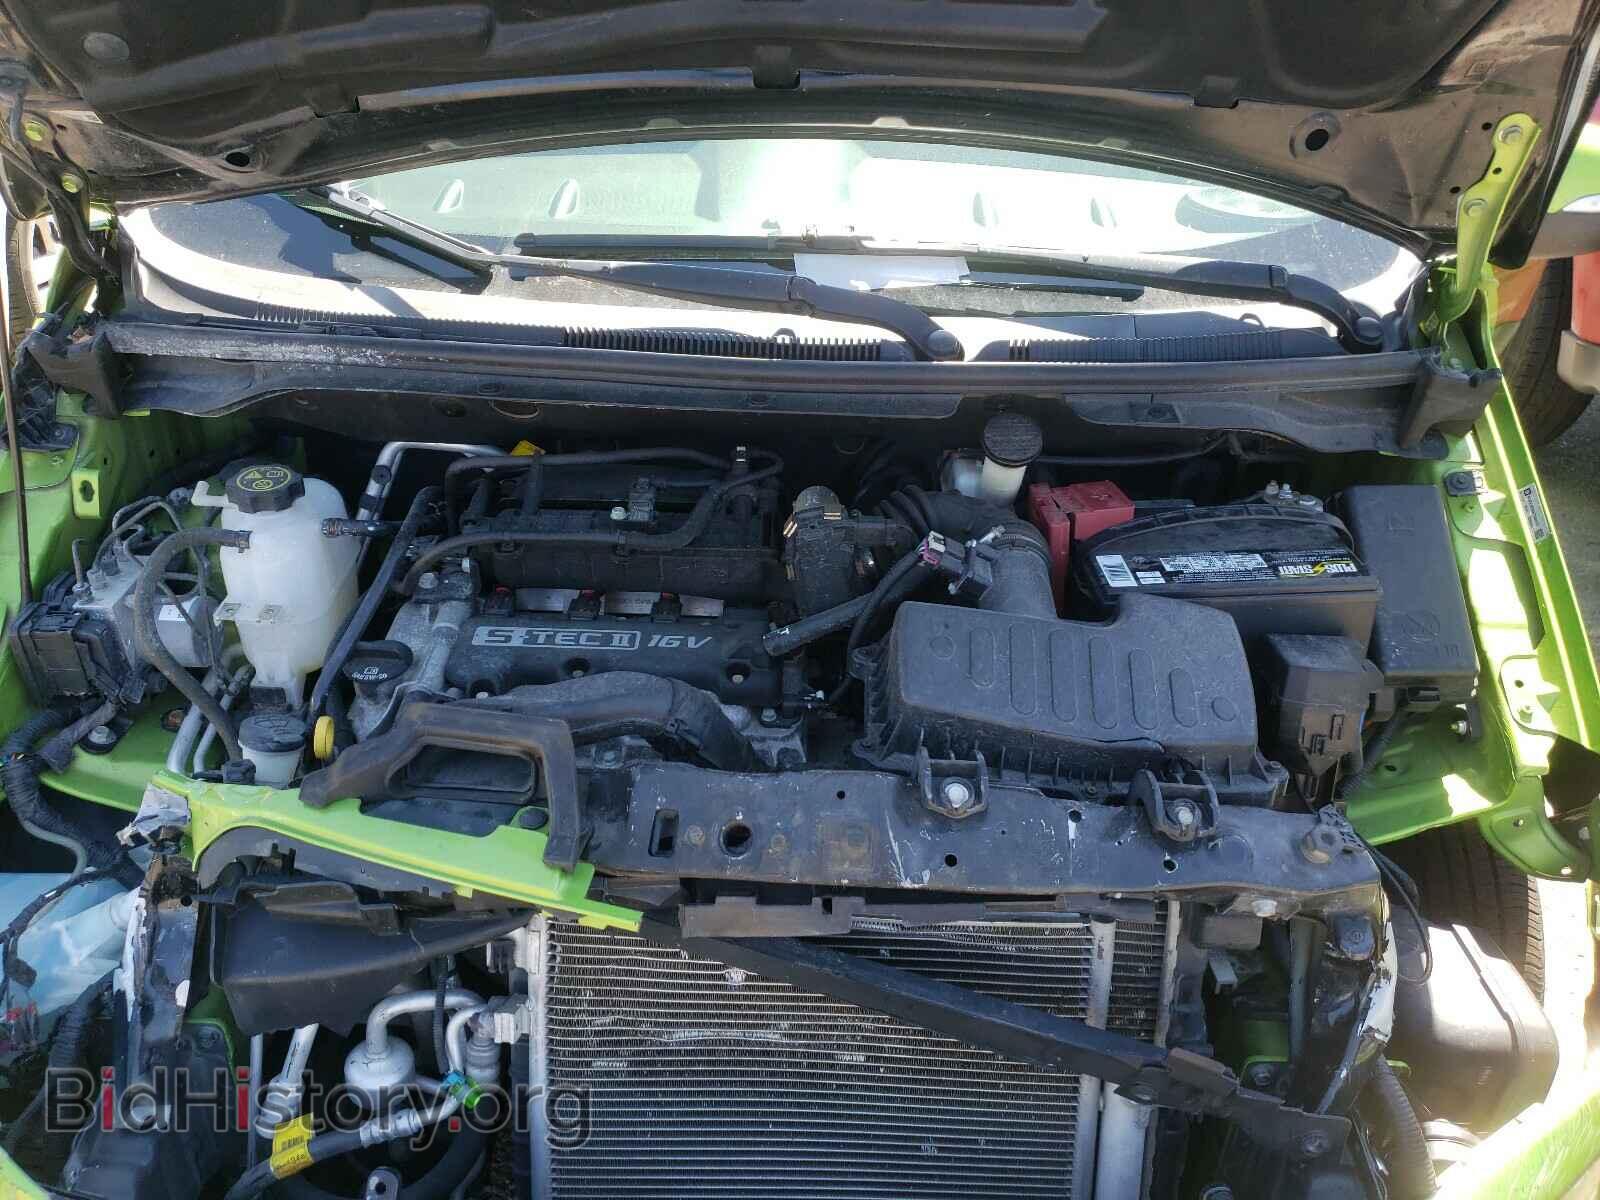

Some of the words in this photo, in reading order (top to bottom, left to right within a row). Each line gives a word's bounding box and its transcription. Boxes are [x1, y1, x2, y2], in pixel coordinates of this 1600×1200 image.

[1278, 564, 1314, 575] START
[1323, 563, 1358, 574] PLUS
[647, 635, 713, 650] 16V
